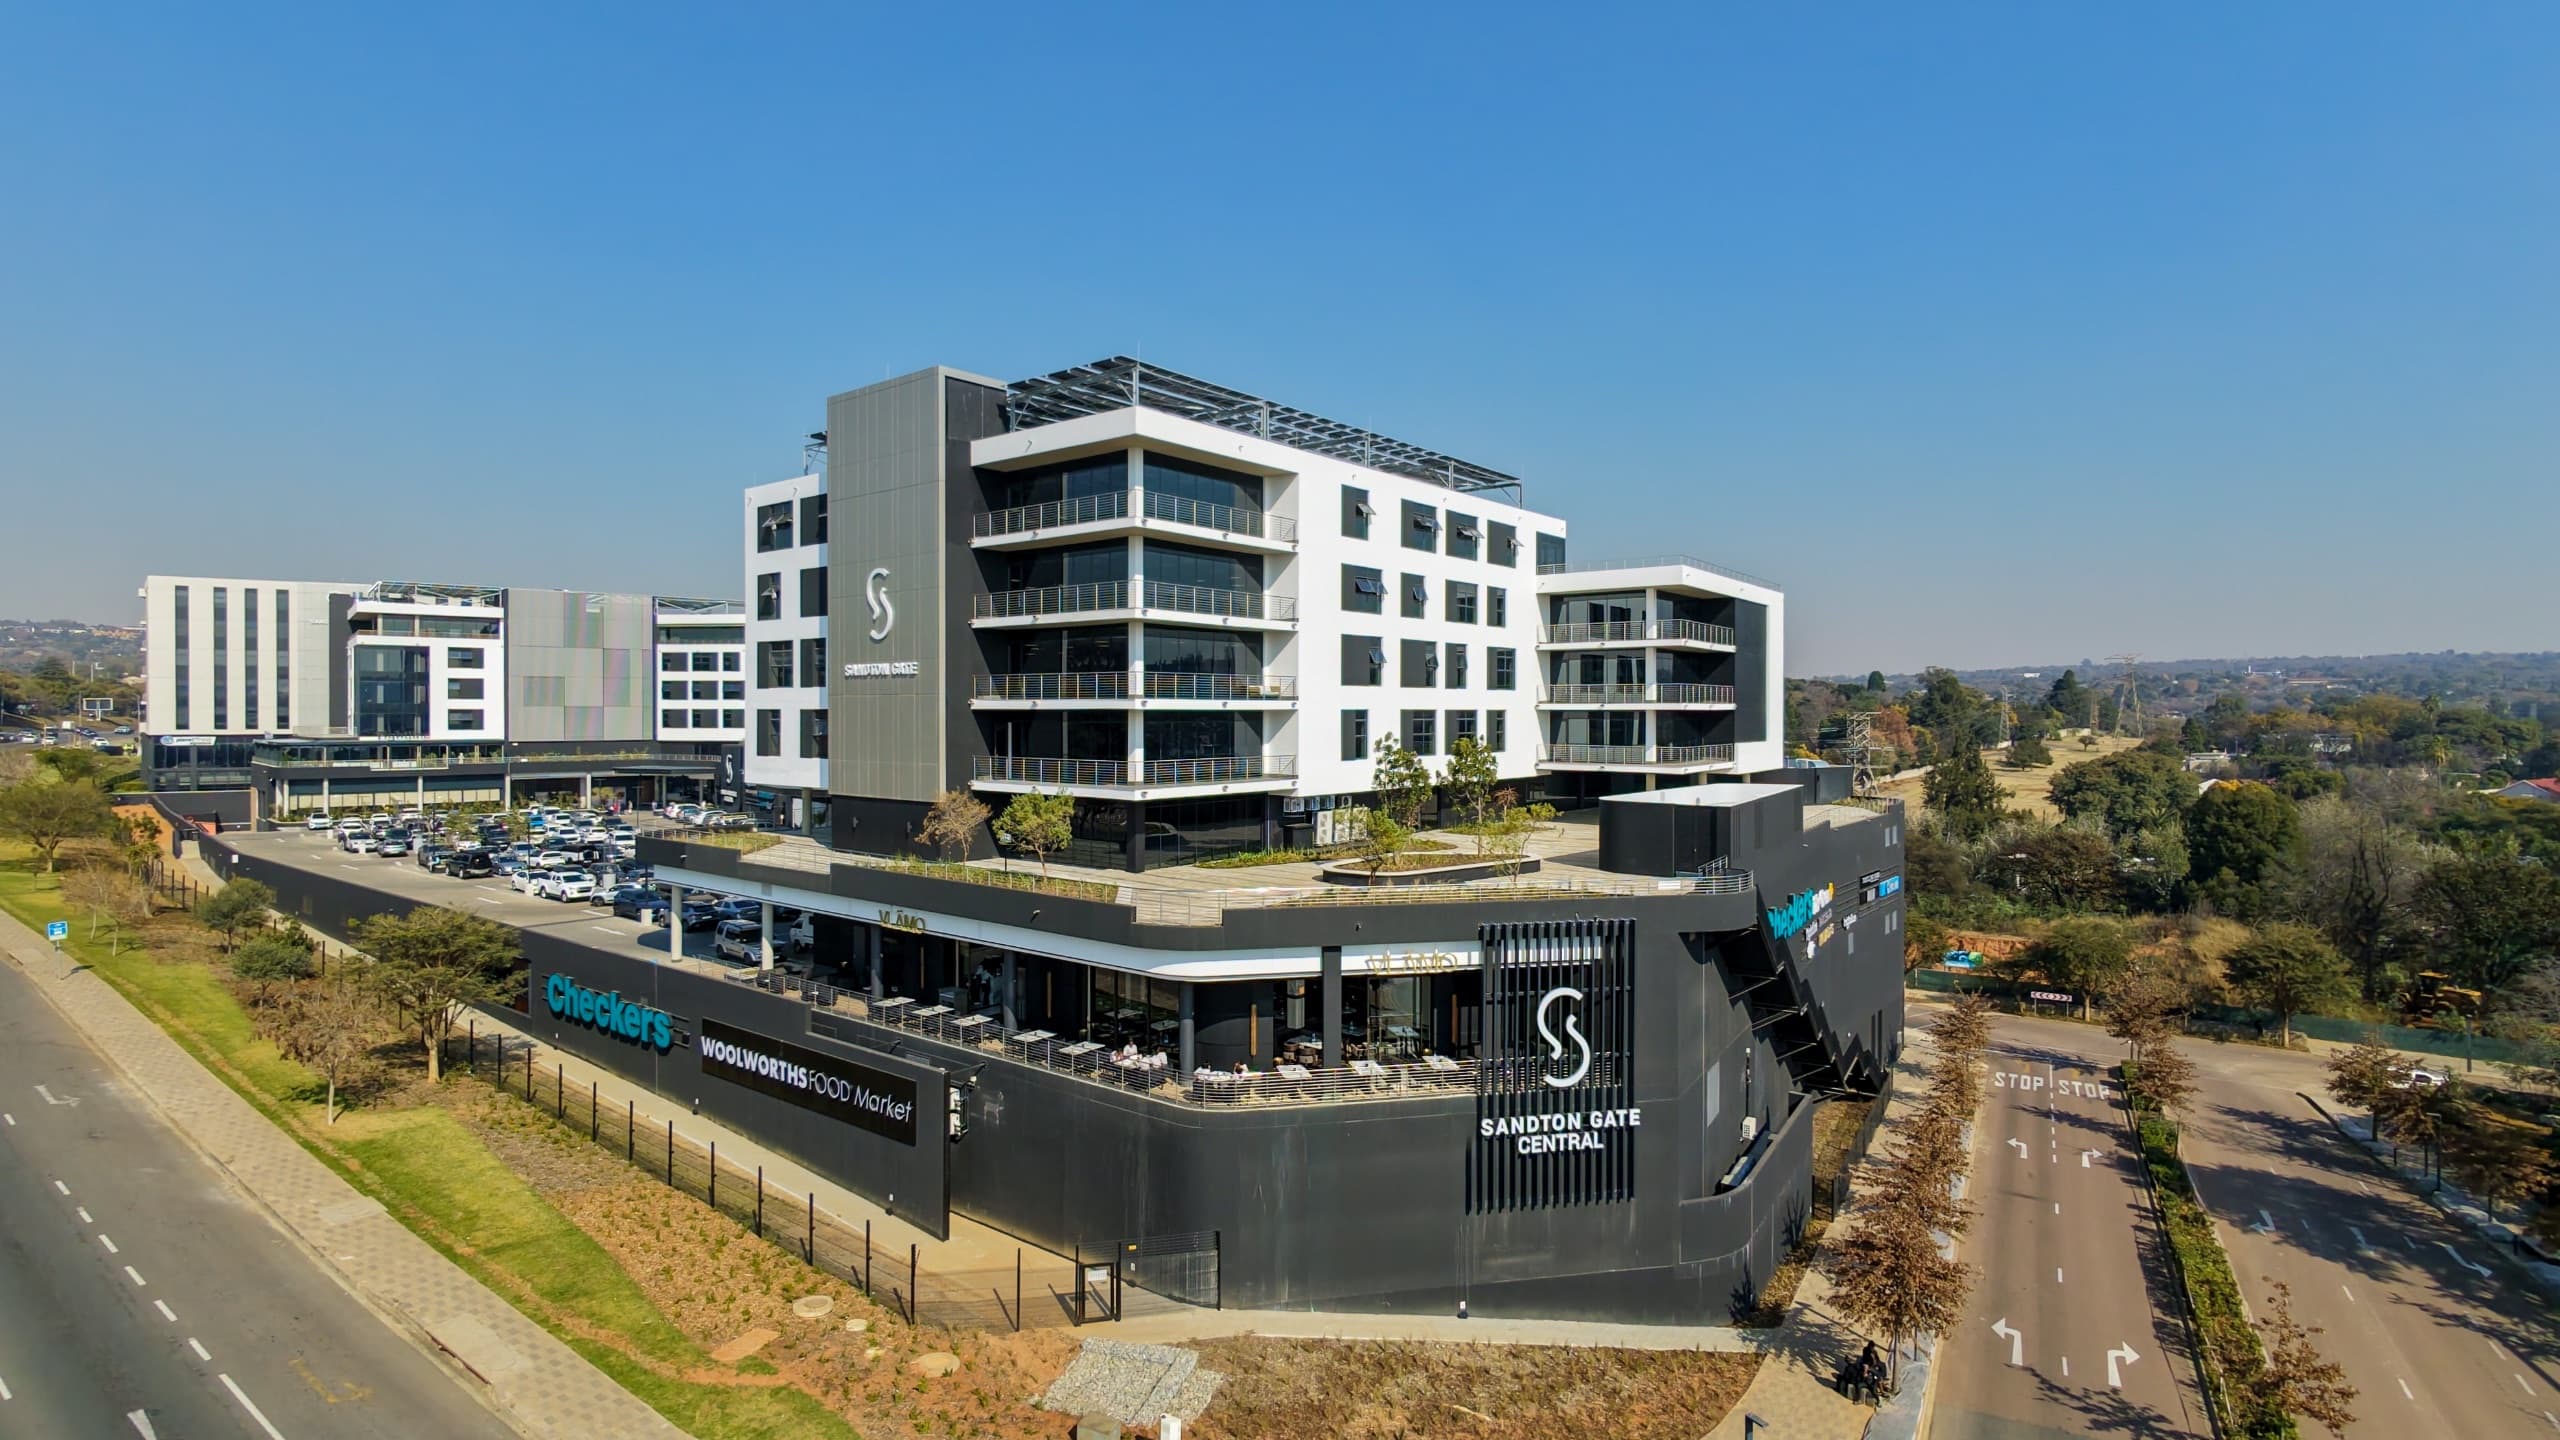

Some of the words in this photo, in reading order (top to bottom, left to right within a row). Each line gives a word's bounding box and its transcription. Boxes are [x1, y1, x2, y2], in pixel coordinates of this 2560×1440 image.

[546, 973, 672, 1049] Checkers
[700, 1035, 808, 1089] WOOLWORTHS
[808, 1070, 850, 1103] FOOD
[853, 1086, 913, 1124] Market
[1994, 1072, 2044, 1091] STOP
[2058, 1080, 2111, 1099] STOP
[1481, 1112, 1581, 1137] SANDTON
[1590, 1108, 1641, 1127] GATE
[1518, 1131, 1604, 1155] CENTRAL
